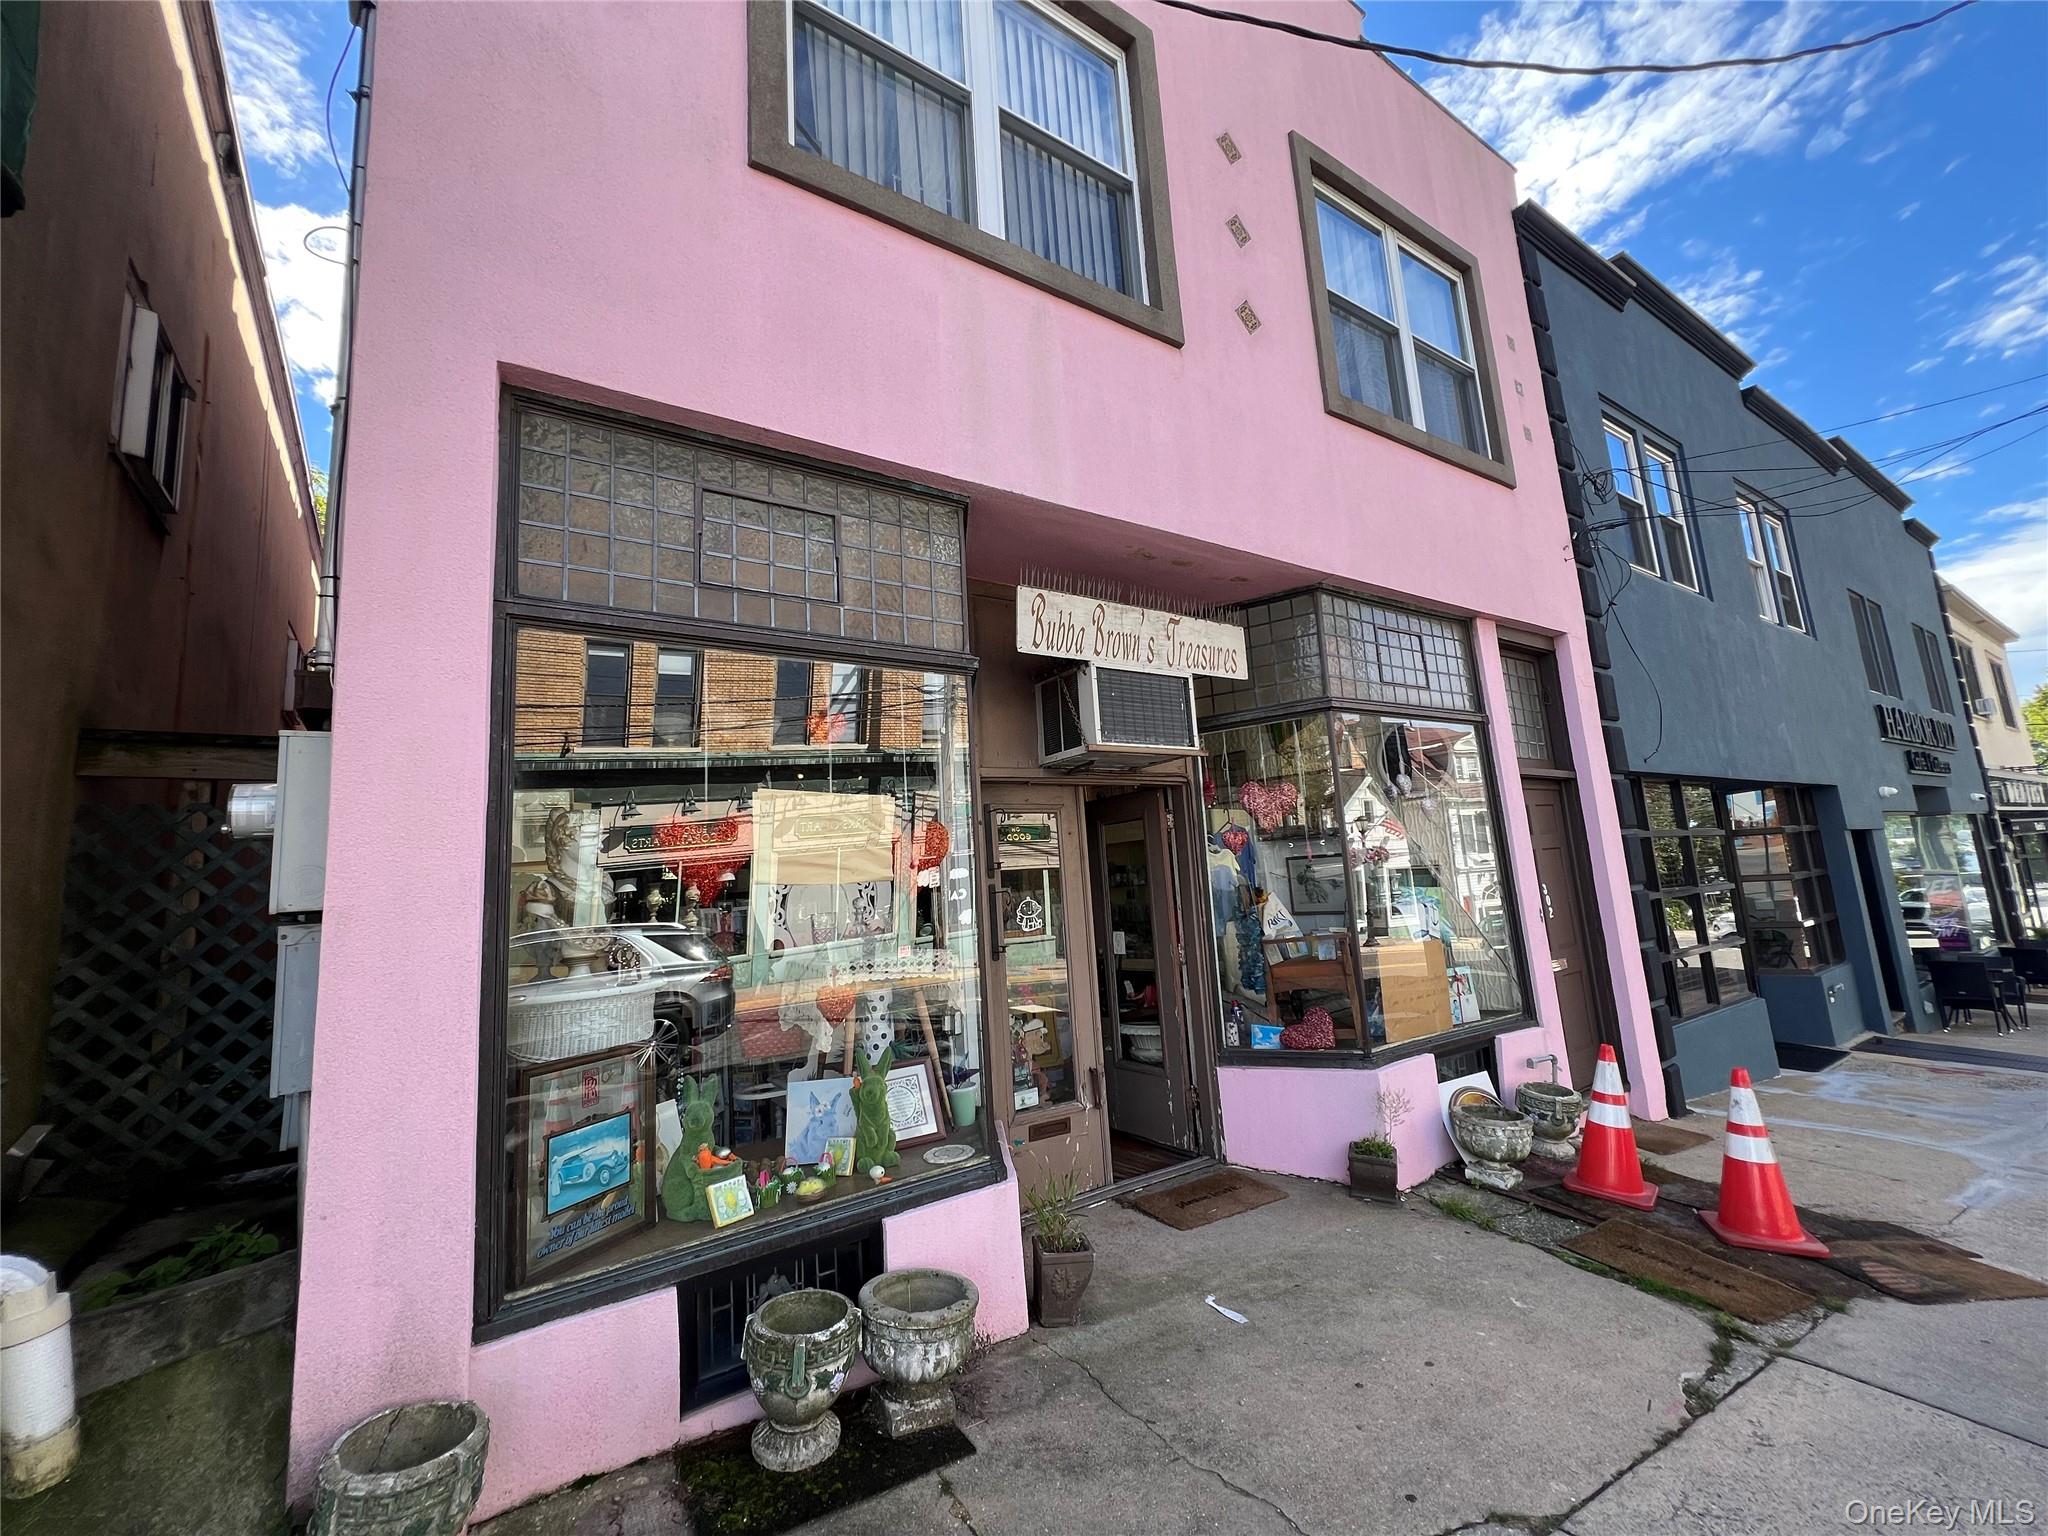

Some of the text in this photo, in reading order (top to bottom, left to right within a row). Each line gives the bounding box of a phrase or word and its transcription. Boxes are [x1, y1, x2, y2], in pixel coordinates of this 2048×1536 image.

[1031, 592, 1238, 674] Bubba Brown's Treasures
